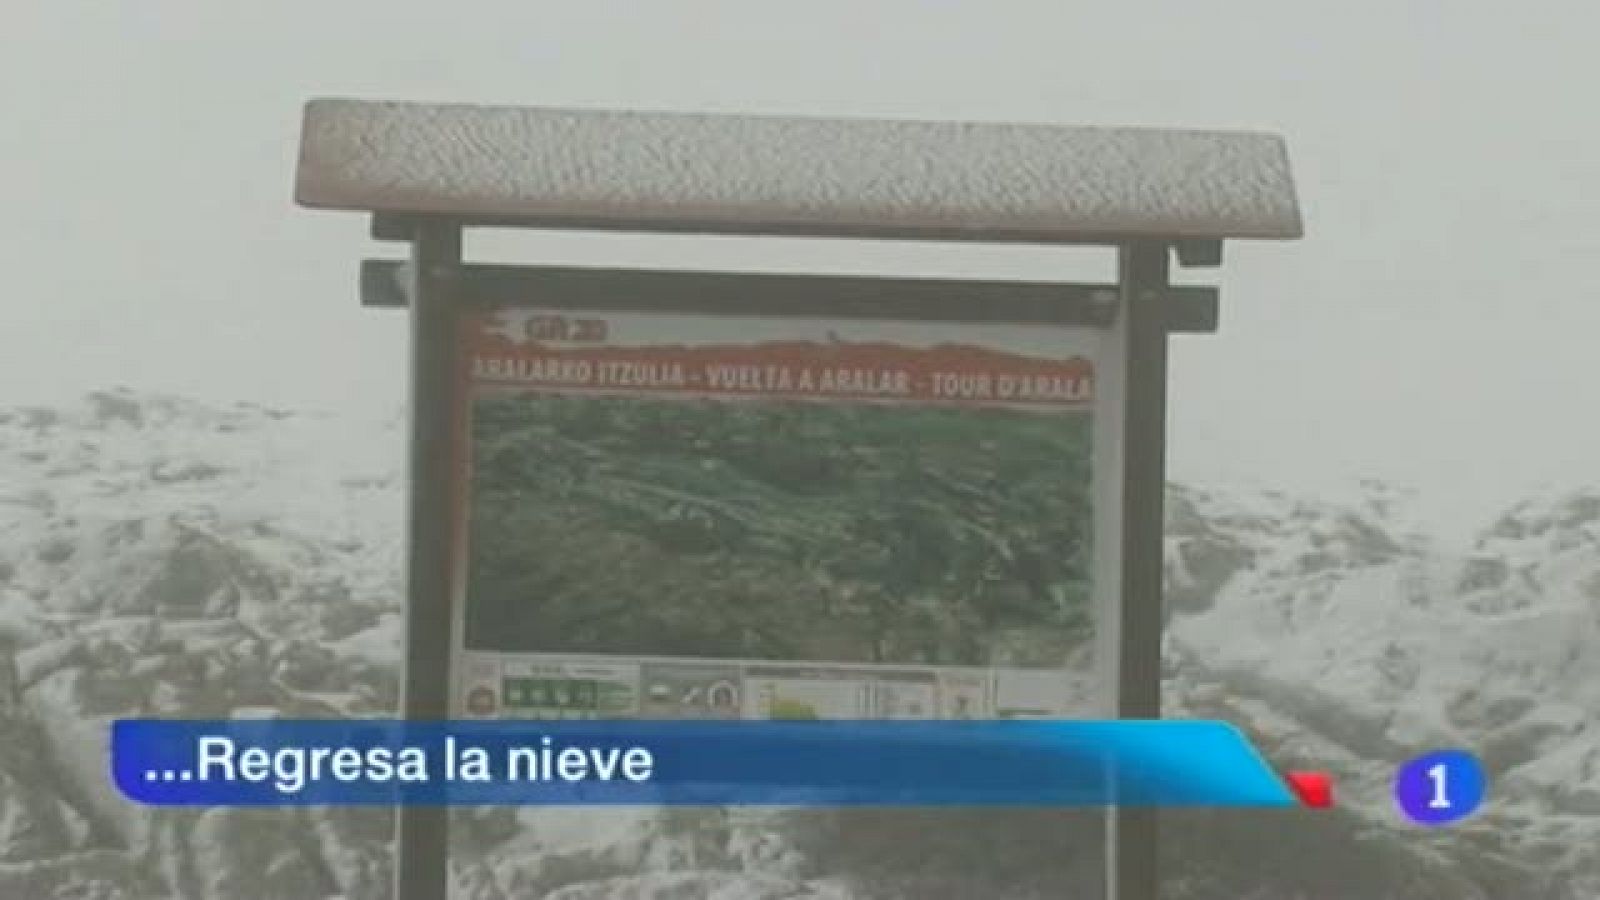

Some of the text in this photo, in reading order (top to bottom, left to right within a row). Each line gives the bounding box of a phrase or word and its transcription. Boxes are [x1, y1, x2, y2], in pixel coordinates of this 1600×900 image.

[599, 360, 685, 385] ITZULIA
[704, 363, 793, 390] VUELTA
[798, 367, 816, 392] A
[820, 368, 910, 393] ARALAR
[932, 372, 991, 397] TOUR
